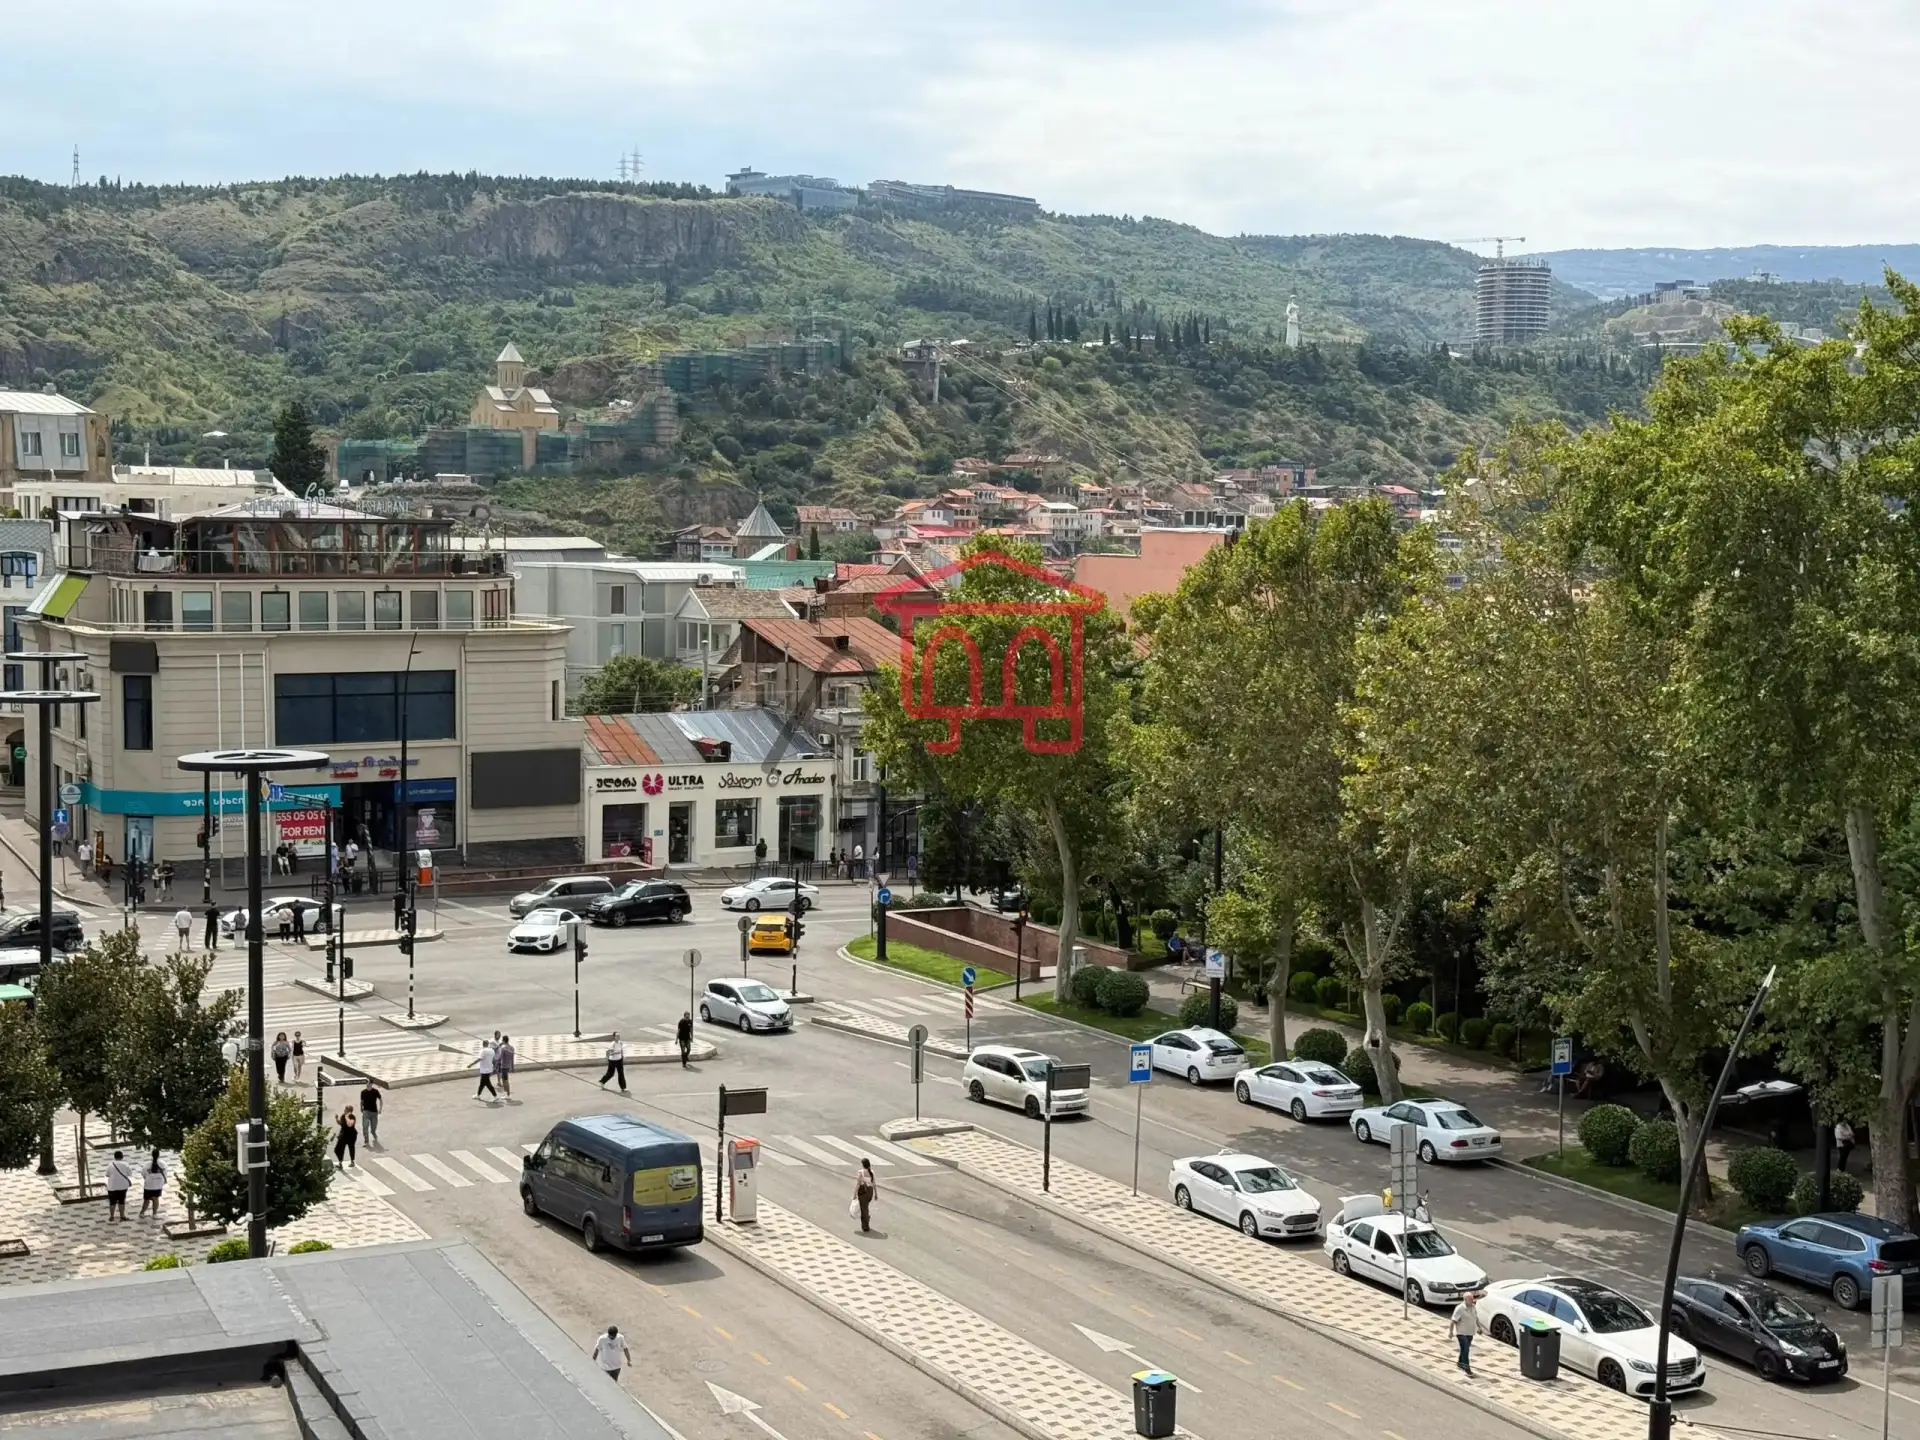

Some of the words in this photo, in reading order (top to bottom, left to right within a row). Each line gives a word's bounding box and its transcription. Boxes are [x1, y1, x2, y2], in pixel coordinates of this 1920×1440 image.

[356, 500, 410, 514] RESTAURANT
[668, 775, 704, 786] ULTRA
[782, 767, 826, 785] Amadeo
[596, 777, 637, 788] ულტრა
[276, 812, 292, 822] 555
[293, 811, 306, 821] 05
[307, 810, 320, 820] 05
[282, 826, 302, 837] FOR
[303, 825, 326, 836] RENT
